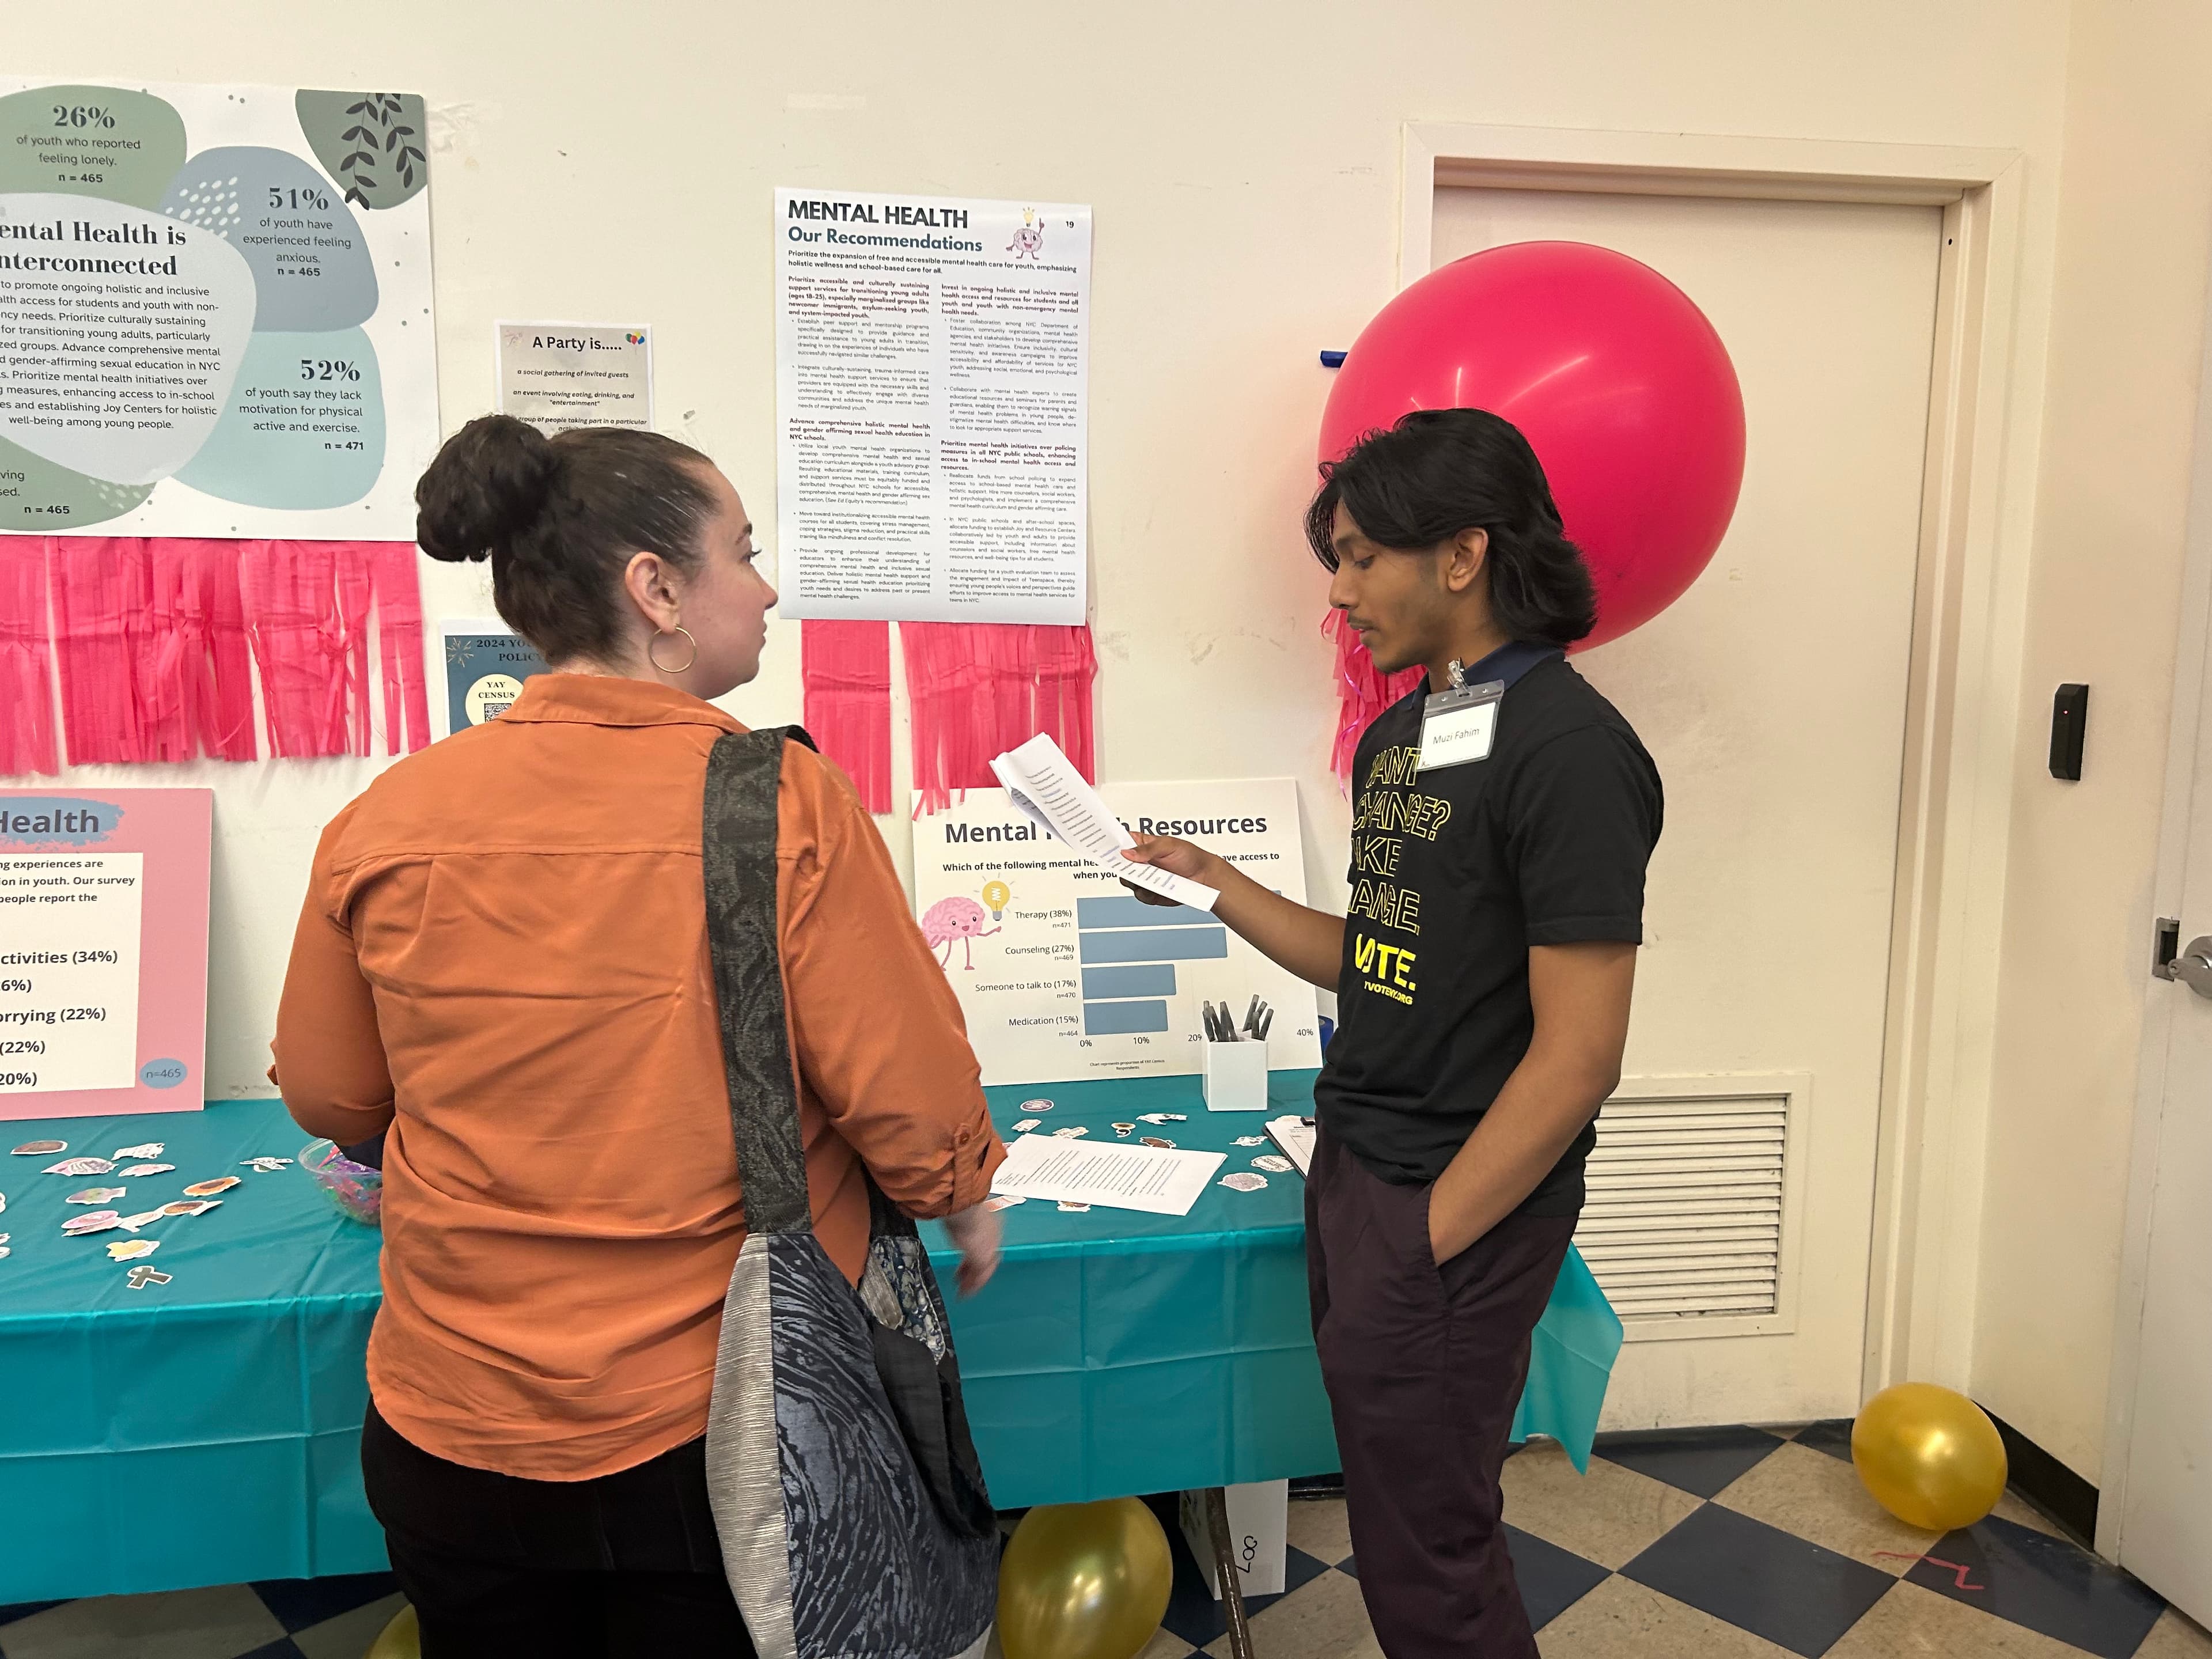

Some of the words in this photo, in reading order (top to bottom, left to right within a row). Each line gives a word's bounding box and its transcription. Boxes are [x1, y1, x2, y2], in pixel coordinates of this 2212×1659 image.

[53, 105, 115, 128] 26%
[16, 135, 28, 144] of
[31, 137, 62, 146] youth
[65, 138, 88, 146] who
[92, 140, 142, 151] reported
[39, 153, 77, 166] feeling
[81, 155, 117, 167] lonely.
[81, 173, 103, 183] 465
[270, 187, 328, 210] 51%
[789, 200, 879, 223] MENTAL
[885, 206, 967, 229] HEALTH
[260, 217, 270, 226] of
[274, 219, 303, 229] youth
[308, 219, 333, 229] have
[0, 221, 63, 240] ental
[73, 221, 158, 244] Health
[167, 226, 185, 245] is
[789, 226, 821, 242] Our
[827, 228, 982, 251] Recommendations
[243, 234, 310, 245] experienced
[314, 237, 351, 249] feeling
[0, 252, 177, 275] nterconnected
[276, 253, 321, 263] anxious.
[299, 267, 320, 276] 465
[533, 336, 543, 348] A
[547, 337, 585, 352] Party
[301, 359, 360, 381] 52%
[245, 387, 256, 396] of
[260, 389, 289, 399] youth
[293, 391, 311, 400] say
[314, 390, 336, 401] they
[340, 391, 362, 400] lack
[240, 404, 297, 414] motivation
[301, 406, 316, 415] for
[319, 407, 363, 417] physical
[9, 416, 63, 427] well-being
[66, 419, 101, 428] among
[104, 421, 134, 429] young
[138, 421, 173, 430] people.
[253, 421, 285, 430] active
[289, 423, 309, 431] and
[313, 423, 359, 433] exercise.
[346, 442, 363, 450] 471
[47, 506, 70, 514] 465
[477, 639, 505, 647] 2024
[1433, 732, 1453, 745] Muzi
[1455, 728, 1480, 740] Fahim
[946, 820, 1036, 843] Mental
[1139, 817, 1267, 836] Resources
[13, 860, 82, 870] experiences
[1004, 861, 1046, 870] following
[1049, 859, 1081, 868] mental
[33, 877, 69, 887] youth.
[97, 878, 135, 886] survey
[40, 895, 75, 904] report
[79, 893, 97, 902] the
[1050, 910, 1071, 918] (38%)
[1006, 946, 1050, 955] Counseling
[1052, 945, 1074, 953] (27%)
[1, 952, 67, 964] ctivities
[73, 950, 118, 964] (34%)
[0, 980, 31, 993] 6%)
[1054, 980, 1076, 989] (17%)
[0, 1010, 56, 1025] orrying
[60, 1007, 105, 1022] (22%)
[1009, 1018, 1054, 1026] Medication
[1056, 1016, 1078, 1025] (15%)
[0, 1041, 45, 1056] (22%)
[146, 1069, 181, 1078] n=465
